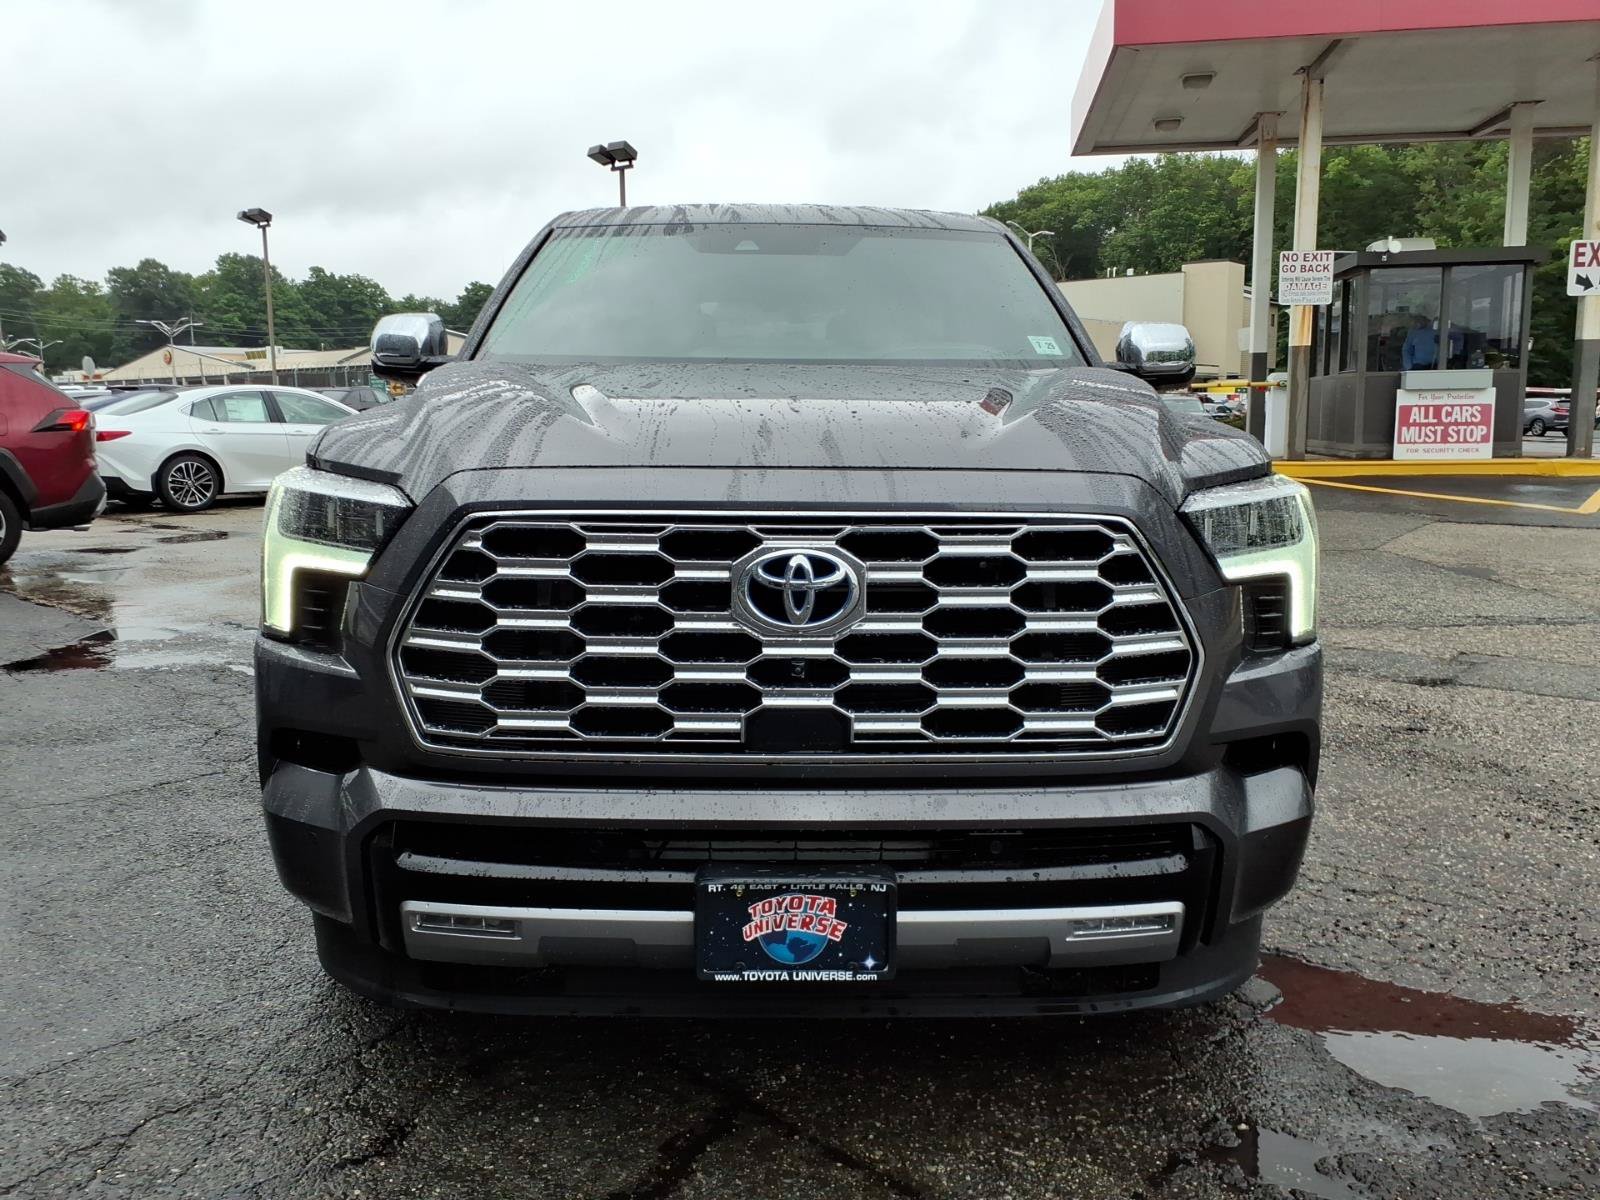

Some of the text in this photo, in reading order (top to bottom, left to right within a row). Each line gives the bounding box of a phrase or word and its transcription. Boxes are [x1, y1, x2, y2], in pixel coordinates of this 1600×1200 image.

[1282, 253, 1331, 262] NO EXIT
[1282, 264, 1330, 273] GO BACK
[1285, 282, 1328, 291] DAMAGE
[1409, 405, 1482, 423] ALL CARS
[1401, 425, 1488, 443] MUST STOP
[708, 884, 726, 892] RT.
[870, 884, 887, 892] NJ
[748, 894, 836, 918] TOYOTA
[742, 912, 847, 942] UNIVERSE
[714, 971, 877, 981] www.TOYOTA UNIVERSE.com
